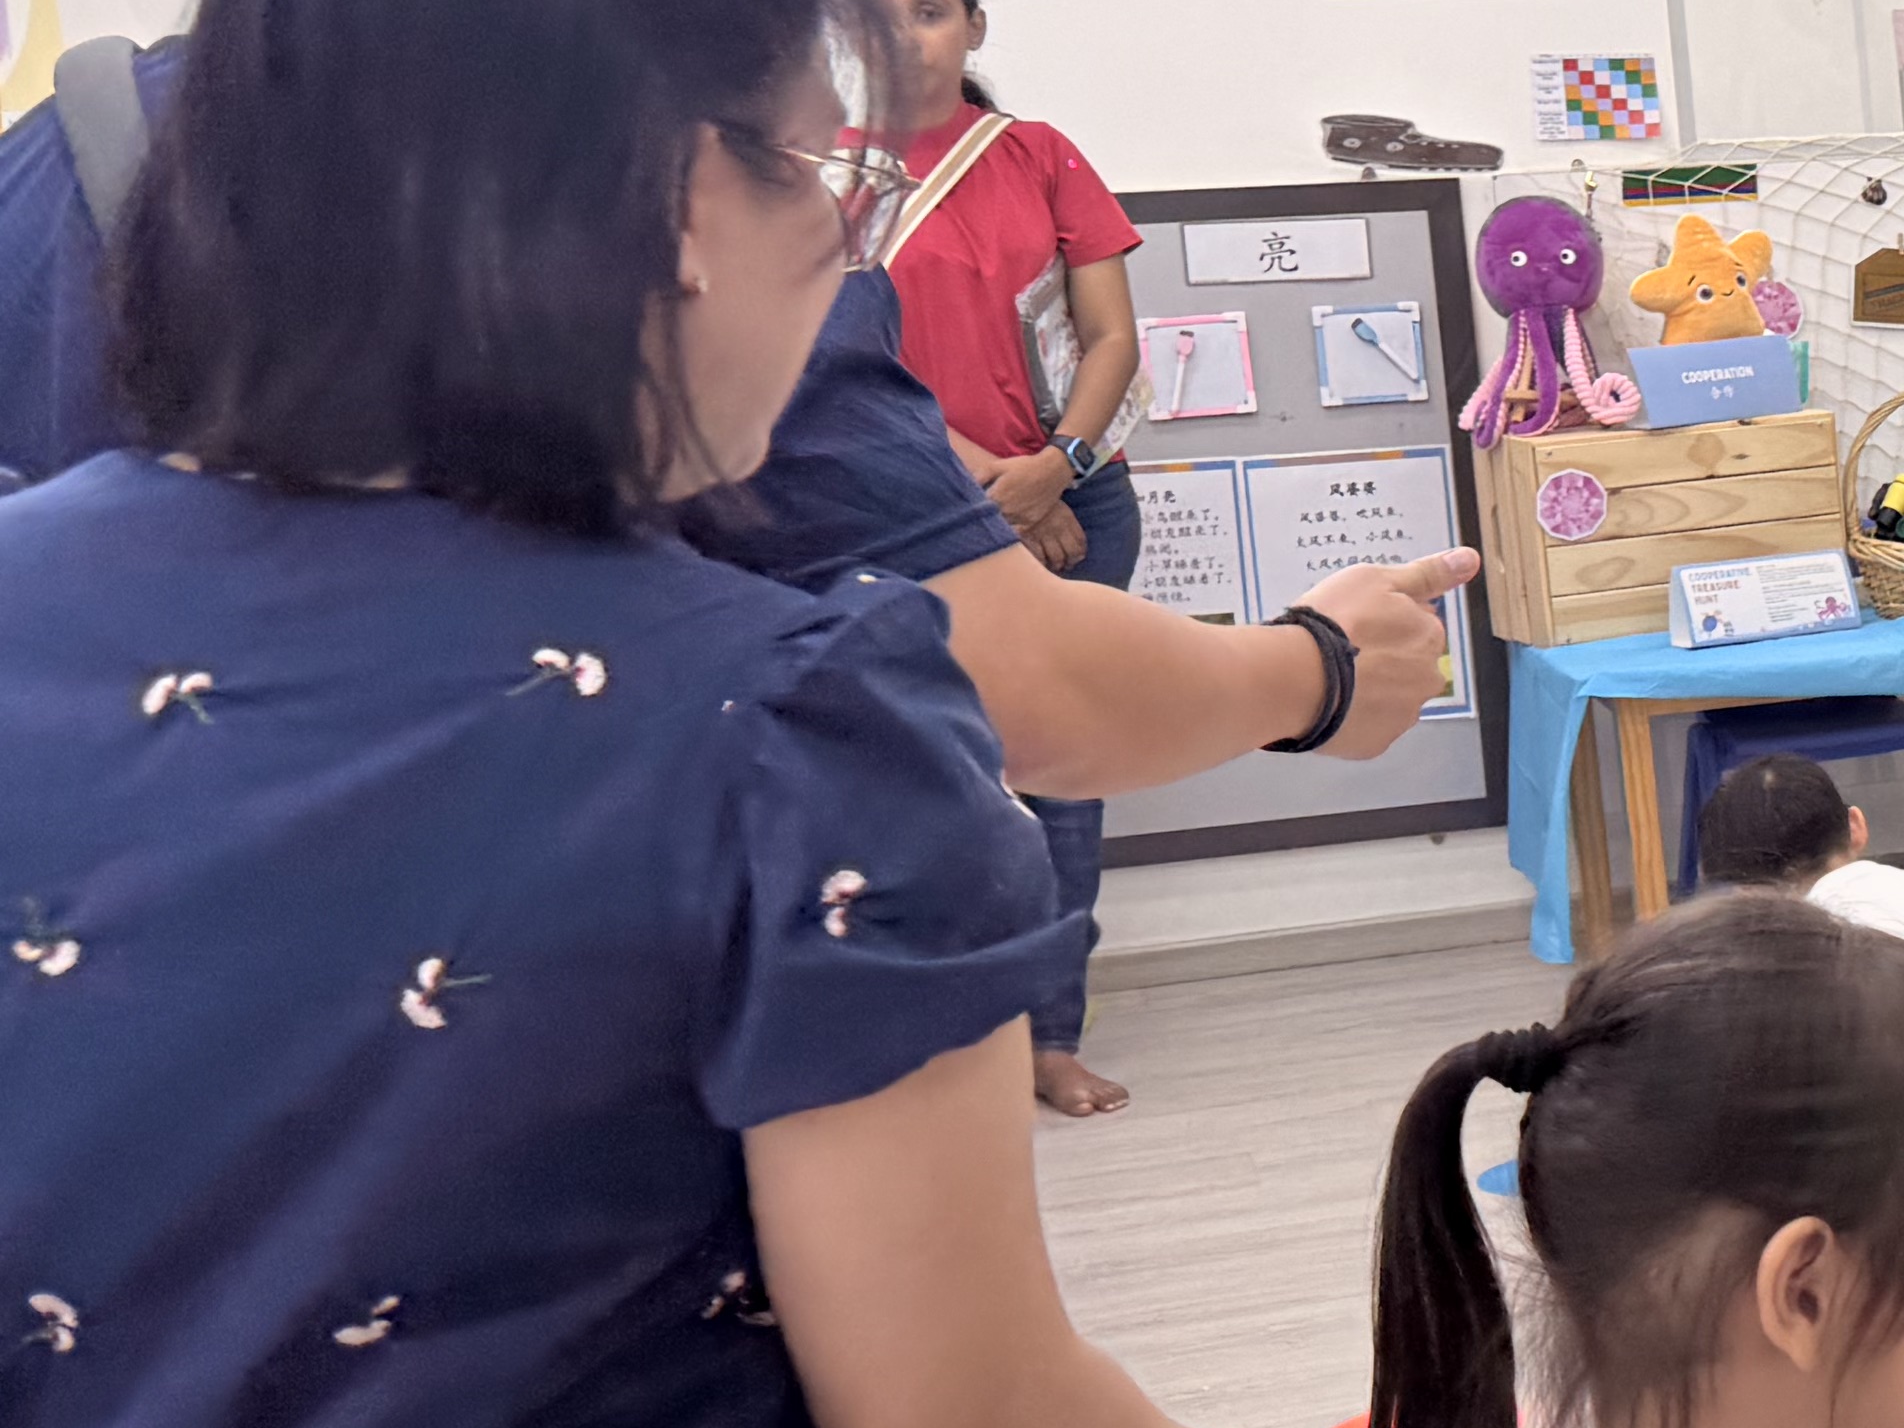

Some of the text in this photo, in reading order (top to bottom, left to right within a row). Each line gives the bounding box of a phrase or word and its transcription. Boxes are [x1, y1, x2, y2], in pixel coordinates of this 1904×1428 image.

[1259, 232, 1299, 273] 亮
[1681, 365, 1755, 384] COOPERATION
[1691, 580, 1741, 593] TREASURE
